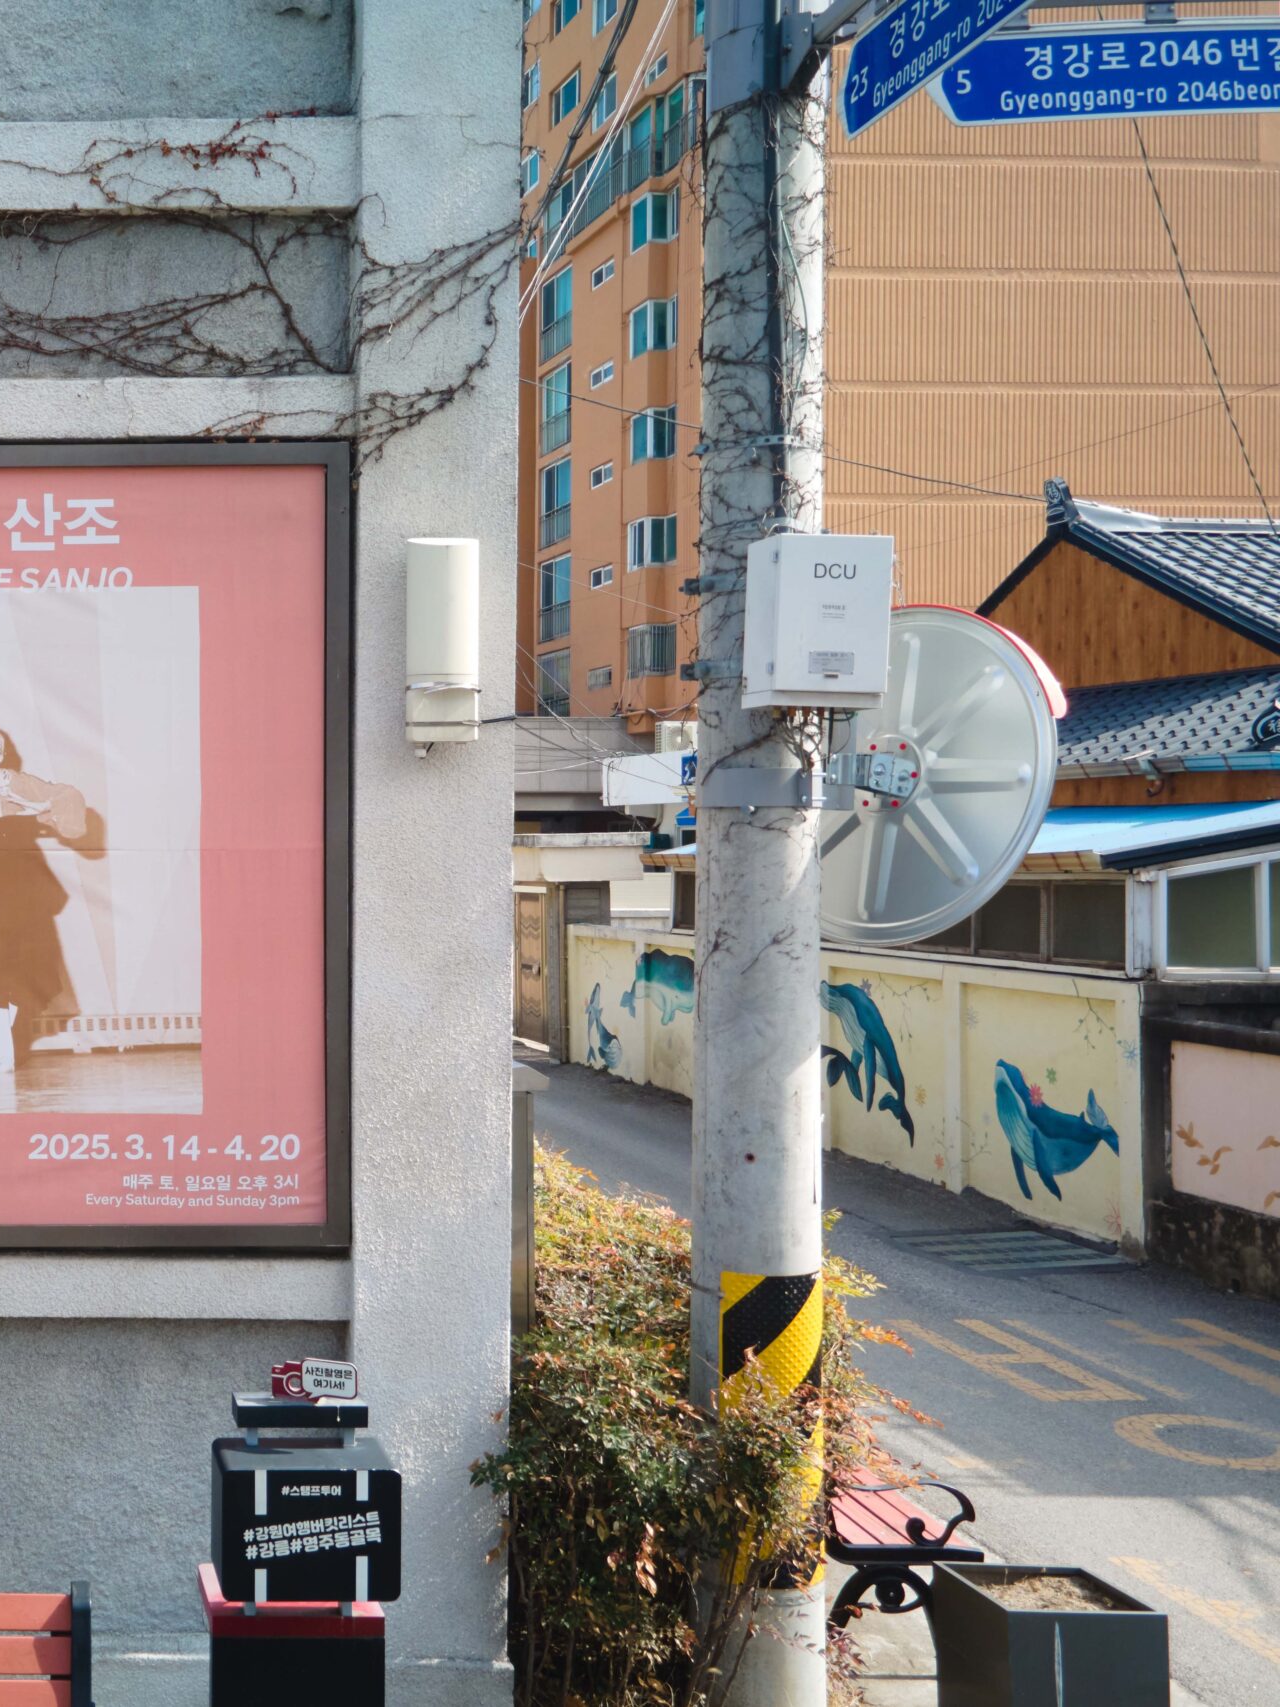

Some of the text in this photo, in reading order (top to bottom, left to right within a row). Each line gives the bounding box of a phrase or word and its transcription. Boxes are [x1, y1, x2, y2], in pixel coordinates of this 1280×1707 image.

[873, 0, 1013, 107] Gyeonggang-ro 202
[850, 65, 869, 105] 23
[956, 69, 972, 95] 5
[1000, 87, 1167, 115] Gyeonggang-ro
[3, 493, 120, 551] 산조
[19, 566, 134, 593] SANJO
[813, 562, 857, 580] DCU
[27, 1133, 118, 1161] 2025.
[124, 1134, 152, 1161] 3.
[162, 1134, 201, 1161] 14
[223, 1134, 252, 1161] 4.
[259, 1134, 301, 1161] 20
[123, 1174, 299, 1191] 매주 토, 일요일 오후 3시
[85, 1193, 300, 1209] Every Saturday and Sunday 3pm
[304, 1366, 353, 1380] 사진촬영은
[313, 1379, 346, 1391] 여기서!
[281, 1485, 342, 1497] #스탬프투어
[243, 1511, 381, 1542] #강원여행버킷리스트
[245, 1527, 382, 1560] #강릉#명주동골목
